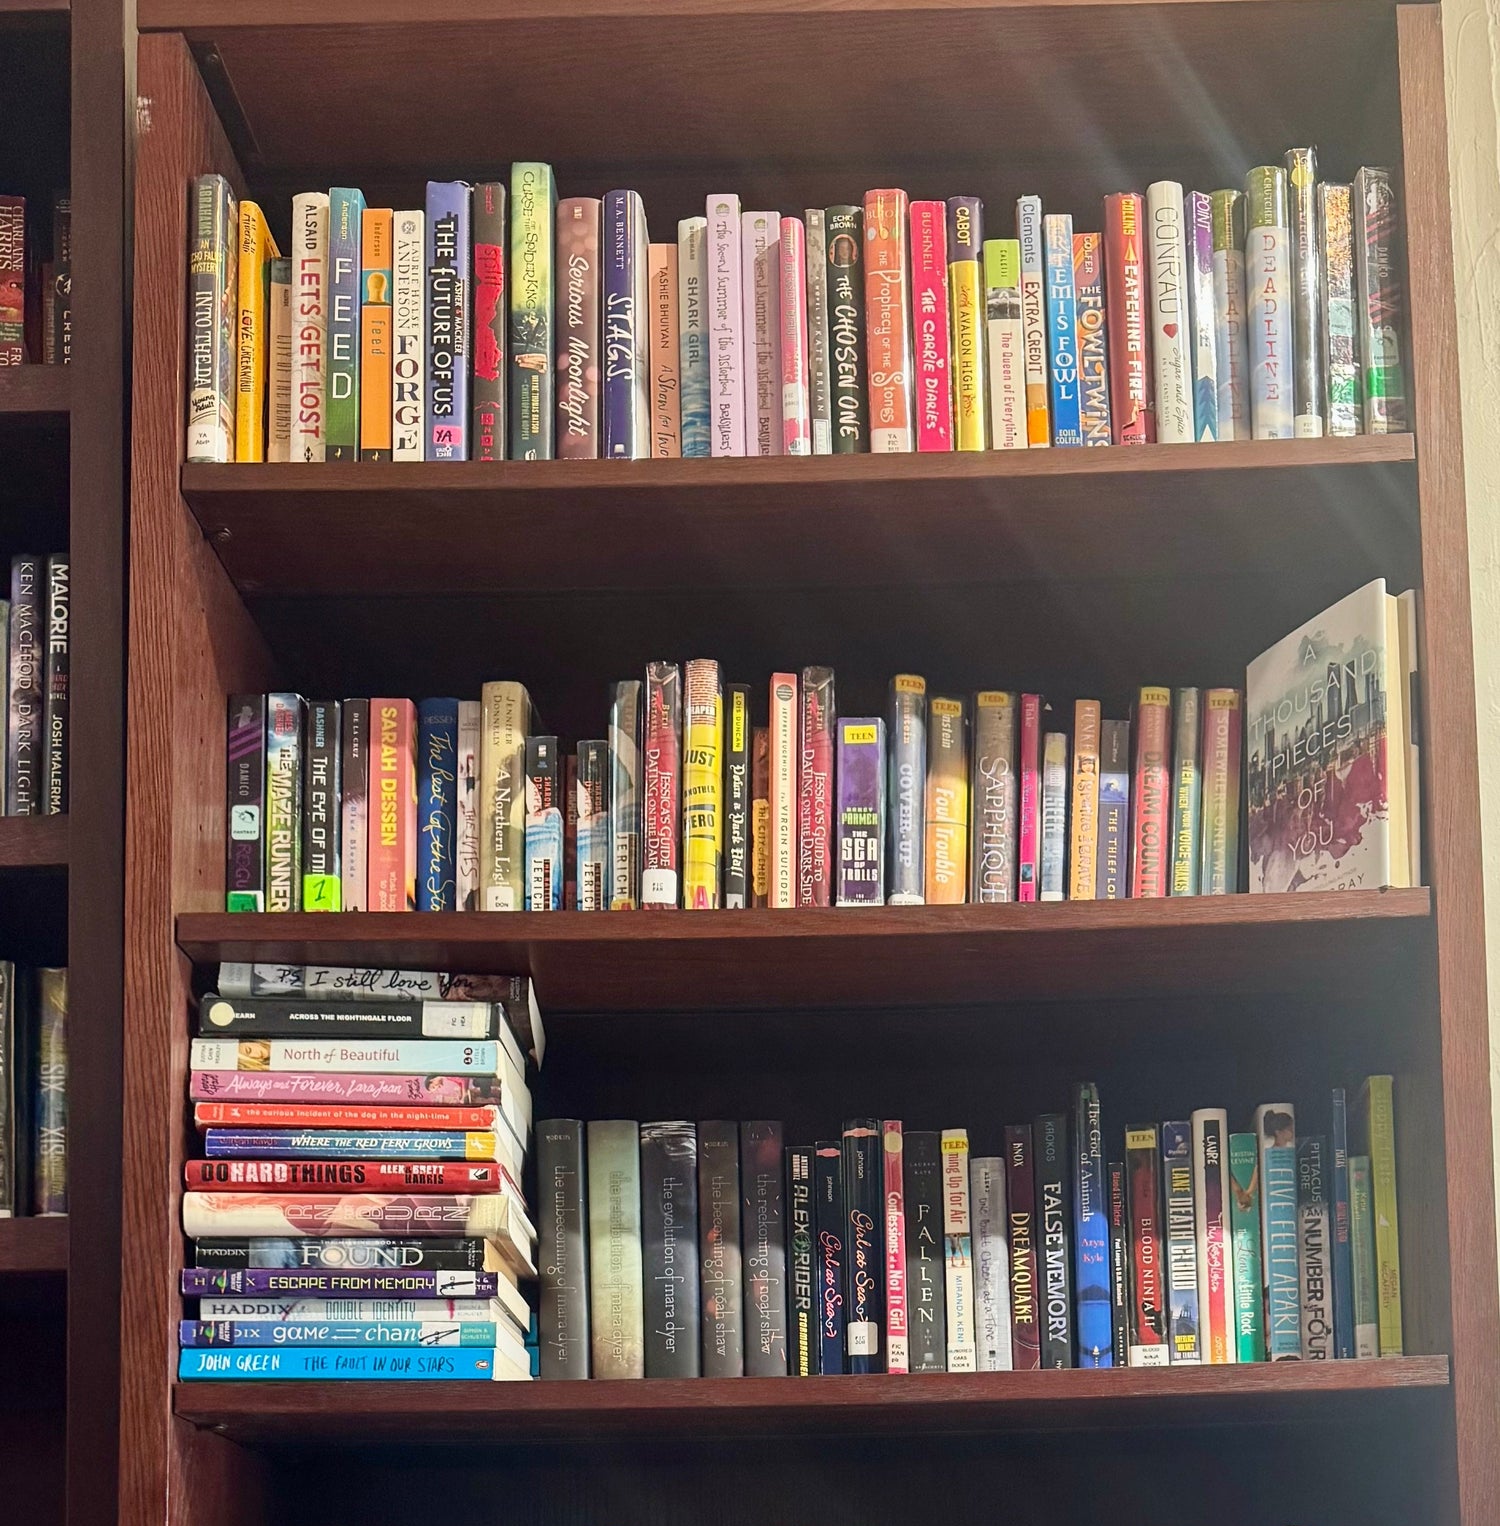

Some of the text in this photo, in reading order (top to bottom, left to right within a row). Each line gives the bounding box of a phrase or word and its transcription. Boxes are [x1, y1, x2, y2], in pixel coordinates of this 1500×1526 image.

[304, 204, 319, 250] ALSAID
[956, 207, 971, 247] CABOT
[1022, 203, 1036, 265] Clements
[1121, 200, 1136, 236] COLLINS
[332, 257, 354, 400] FEED
[397, 239, 410, 329] ANDERSON
[659, 266, 670, 350] TASHIE BHUIYAN
[688, 276, 700, 368] SHARK GIRL
[1024, 281, 1044, 376] EXTRA CREDIT
[299, 258, 321, 439] LET'S GET LOST
[559, 254, 590, 437] Serious Moonlight
[834, 275, 859, 441] THE CHOSEN ONE
[960, 311, 973, 392] AVALON HIGH
[1124, 264, 1143, 401] CATCHING FIRE
[395, 334, 421, 450] FORGE
[50, 563, 69, 655] MALORIE
[18, 562, 33, 753] KEN MACLEOD DARK
[1251, 649, 1376, 733] THOUSAND
[1302, 644, 1316, 665] A
[50, 713, 63, 816] JOSH MALERMA
[315, 707, 325, 748] DASHNER
[1272, 714, 1352, 778] PIECES
[312, 756, 328, 849] THE EYE OF
[380, 707, 398, 846] SARAH DESSEN
[1297, 779, 1326, 810] OF
[780, 805, 788, 903] VIRGIN SUICIDES
[1288, 820, 1334, 862] YOU
[283, 1047, 401, 1063] North of Beautiful
[291, 1136, 453, 1151] WHERE THE RED FERN GROWS
[269, 1276, 436, 1290] ESCAPE FROM MEMORY
[301, 1246, 424, 1267] FOUND
[655, 1177, 685, 1353] the evolution of mara dyer
[1043, 1181, 1067, 1344] FALSE MEMORY
[1141, 1218, 1156, 1327] BLOOD NINJA II
[1268, 1168, 1300, 1338] FIVE FEET APART
[197, 1353, 280, 1371] JOHN GREEN
[304, 1355, 455, 1373] THE FAULT IN OUR STARS
